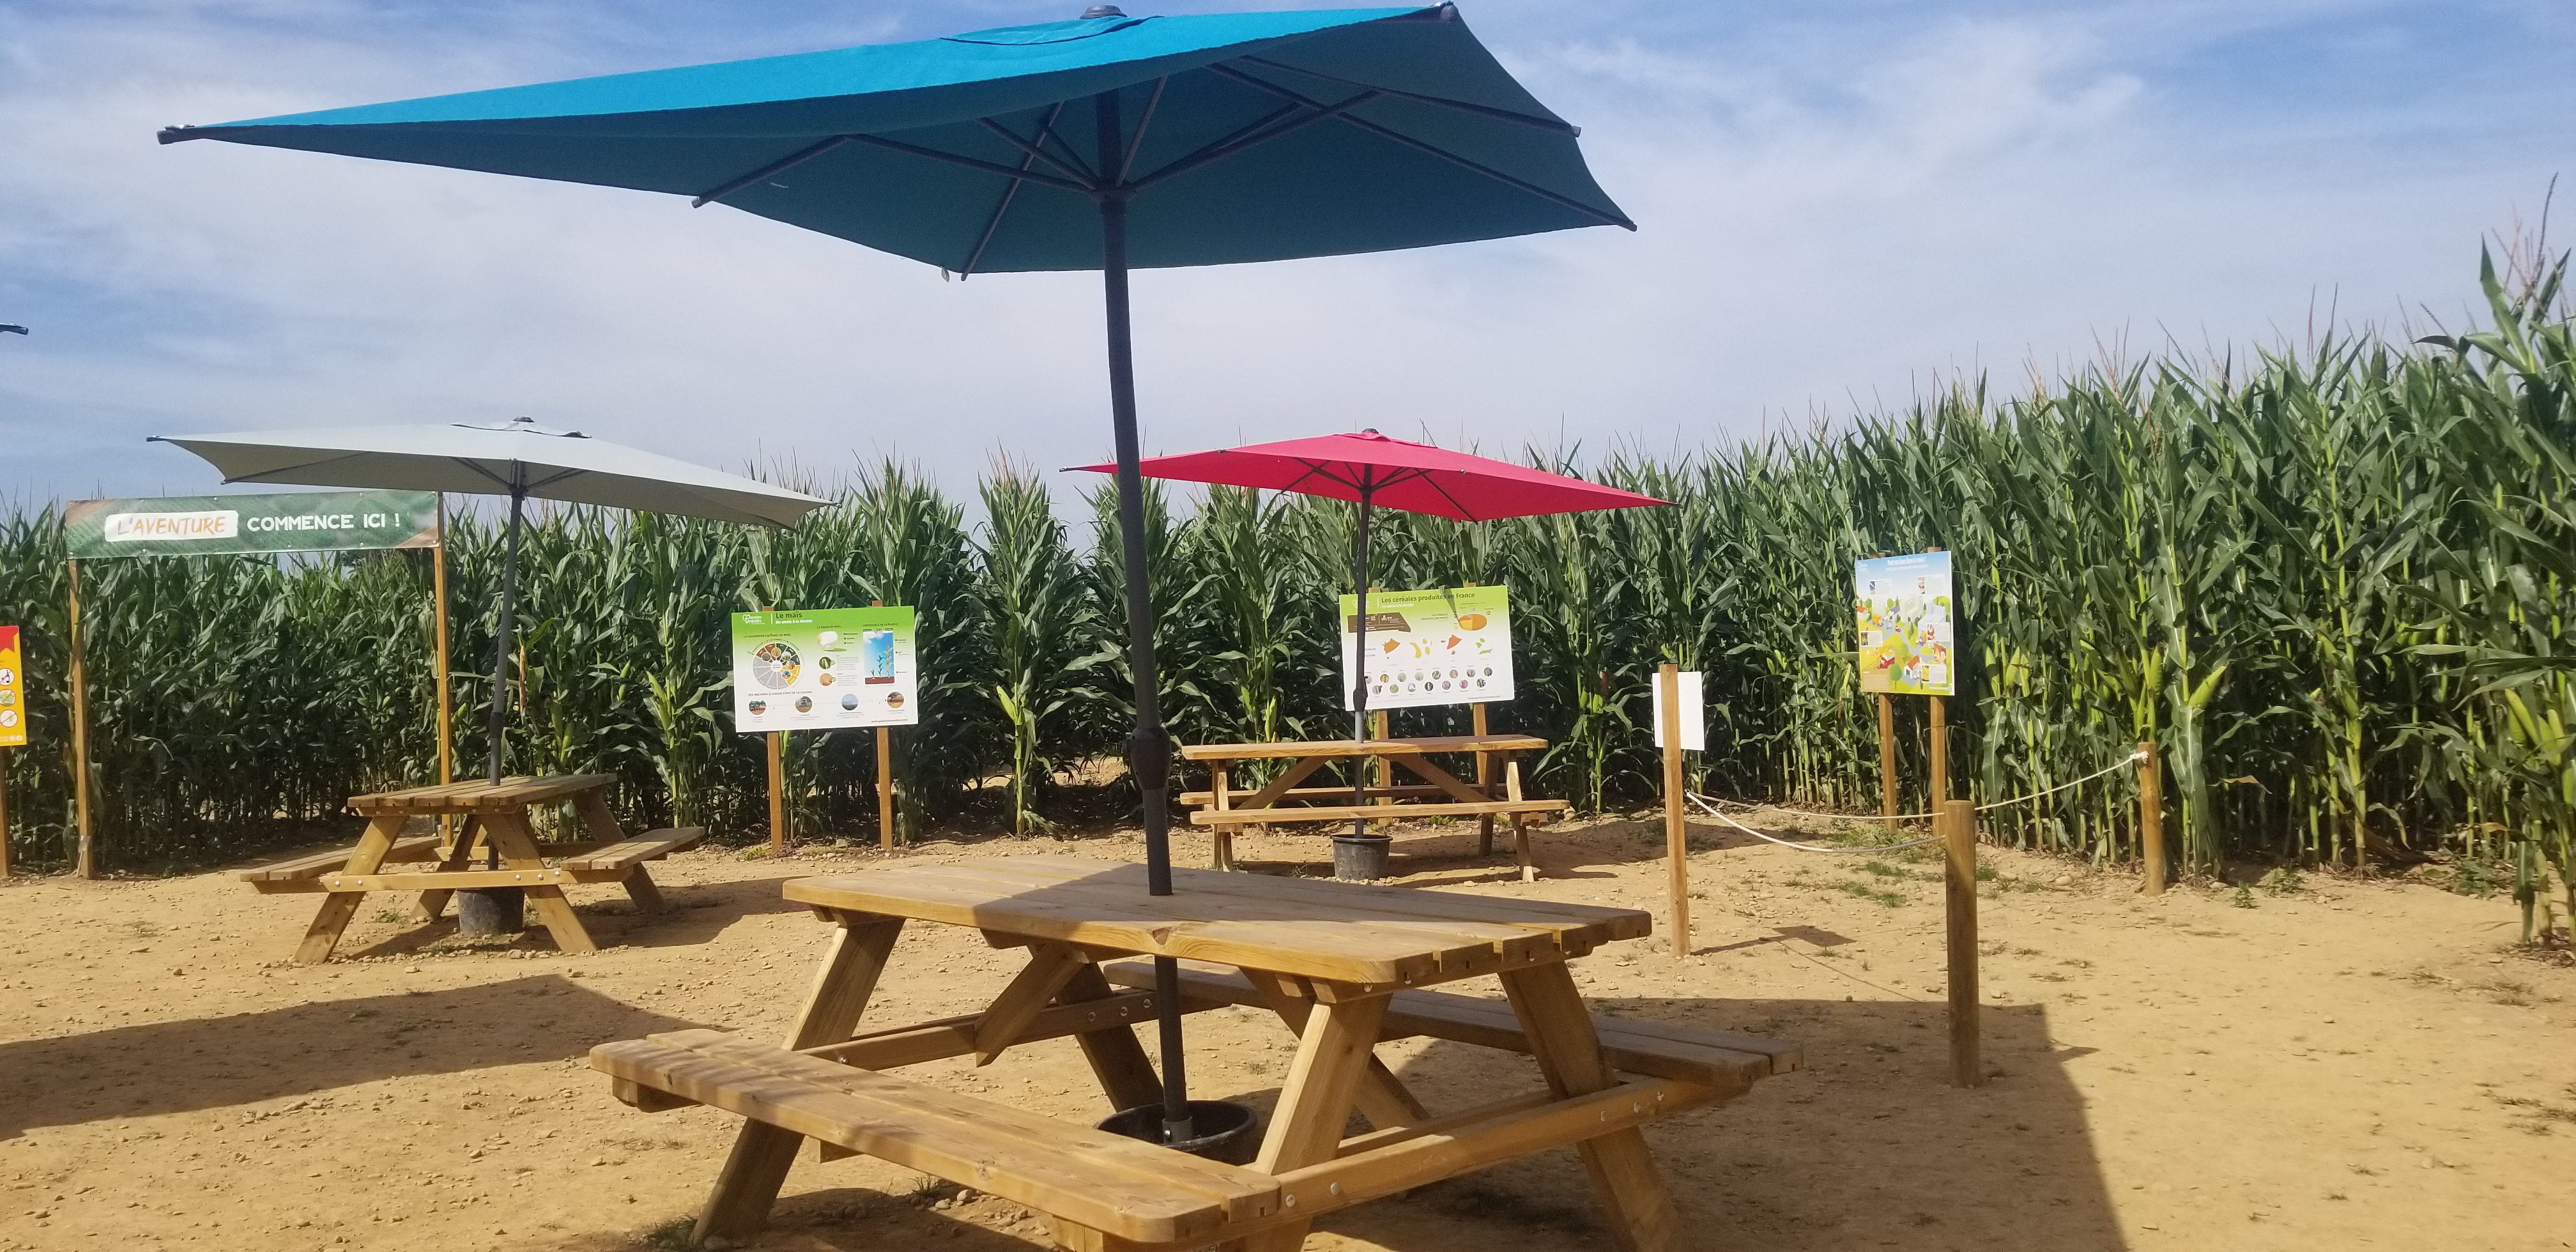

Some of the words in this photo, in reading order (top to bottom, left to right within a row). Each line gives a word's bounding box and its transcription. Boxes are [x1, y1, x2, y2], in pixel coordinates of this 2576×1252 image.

[118, 516, 226, 536] L'AVENTURE
[247, 514, 355, 531] COMMENCE
[364, 514, 385, 528] ICI
